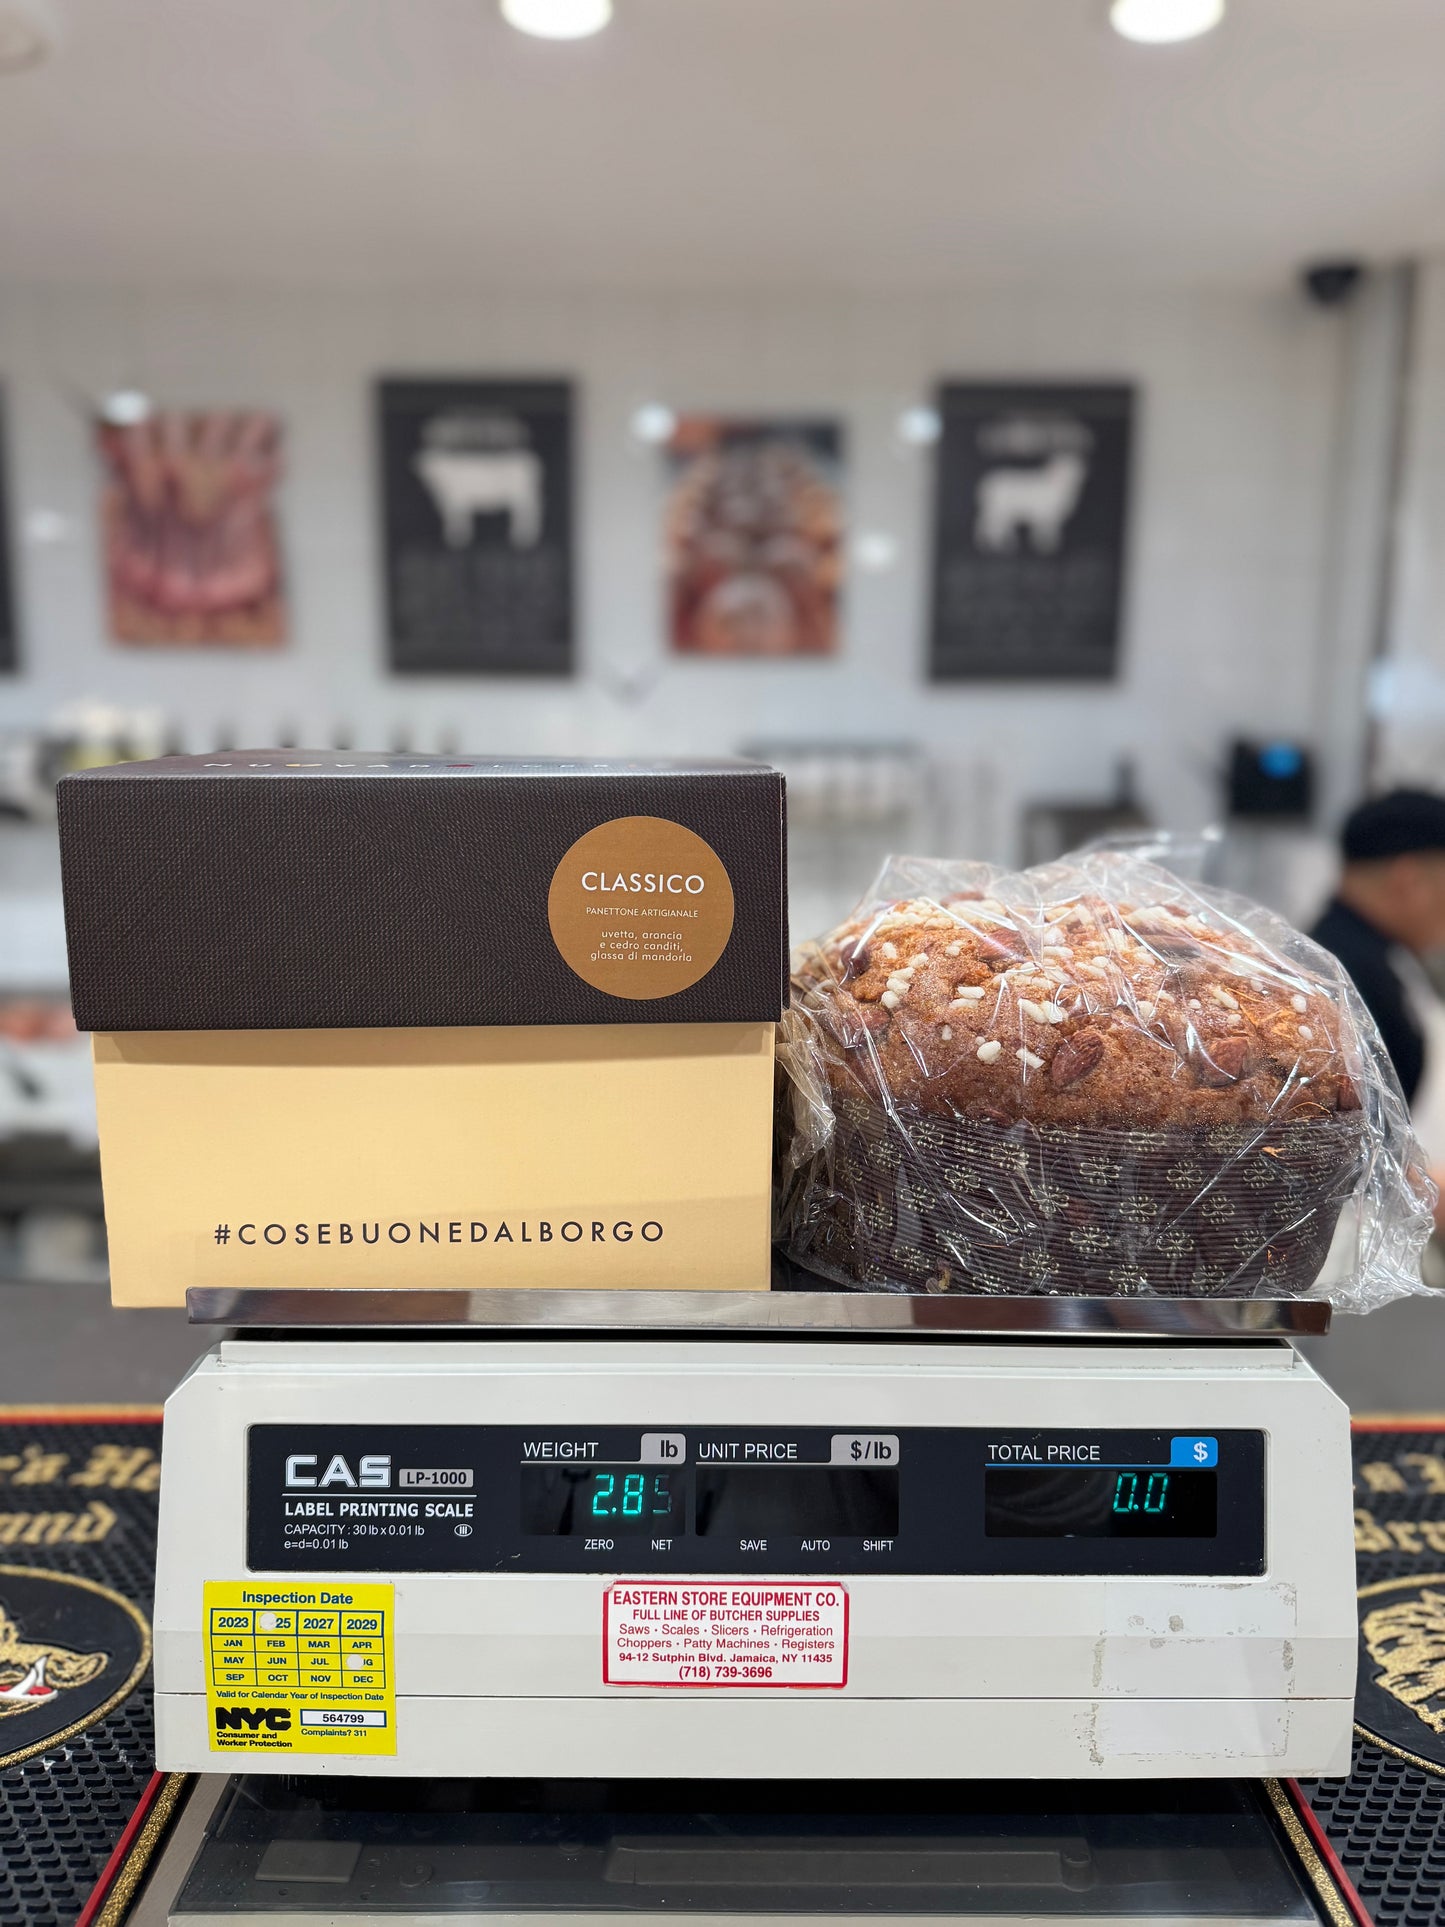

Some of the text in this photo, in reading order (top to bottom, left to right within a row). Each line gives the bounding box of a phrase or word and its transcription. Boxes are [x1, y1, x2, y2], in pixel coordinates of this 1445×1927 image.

[581, 871, 705, 894] CLASSICO
[586, 907, 699, 918] PANETTONE ARTIGIANALE
[601, 930, 682, 940] uvetta, arancia
[610, 941, 640, 950] cedro
[643, 942, 683, 952] canditi,
[590, 951, 692, 962] glassa di mandorla
[213, 1220, 665, 1246] #COSEBUONEDALBORGO
[523, 1442, 599, 1458] WEIGHT
[660, 1440, 679, 1458] lb
[699, 1443, 798, 1459] UNIT PRICE
[850, 1441, 892, 1461] $/lb
[988, 1445, 1100, 1461] TOTAL PRICE
[1193, 1441, 1208, 1463] $
[285, 1454, 391, 1488] CAS
[407, 1471, 467, 1485] LP-1000
[1113, 1472, 1169, 1513] 0.0
[285, 1502, 474, 1518] LABEL PRINTING SCALE
[353, 1524, 367, 1535] 30
[369, 1524, 379, 1535] lb
[381, 1527, 387, 1535] x
[389, 1525, 412, 1535] 0.01
[414, 1525, 425, 1536] lb
[284, 1539, 349, 1549] e=d=0.01 lb
[584, 1539, 615, 1551] ZERO
[651, 1539, 673, 1551] NET
[739, 1539, 767, 1551] SAVE
[800, 1539, 830, 1551] AUTO
[863, 1539, 894, 1551] SHIFT
[242, 1591, 353, 1605] Inspection Date
[613, 1591, 840, 1607] EASTERN STORE EQUIPMENT CO.
[633, 1609, 820, 1622] FULL LINE OF BUTCHER SUPPLIES
[218, 1617, 249, 1628] 2023
[303, 1618, 334, 1629] 2027
[346, 1619, 378, 1630] 2029
[619, 1624, 833, 1639] Saws Scales Slicers Refrigeration
[267, 1640, 286, 1648] FEB
[617, 1637, 835, 1651] Choppers Patty Machines Registers
[267, 1657, 287, 1665] JUN
[619, 1653, 833, 1664] 94-12 Sutphin Blvd. Jamaica, NY 11435
[268, 1674, 288, 1682] OCT
[679, 1666, 773, 1680] (718) 739-3696
[251, 1691, 288, 1699] Calendar
[320, 1693, 362, 1701] Inspection
[215, 1707, 291, 1731] NYC
[322, 1714, 364, 1723] 564799
[301, 1728, 352, 1737] Complaints?
[217, 1739, 293, 1748] Worker Protection
